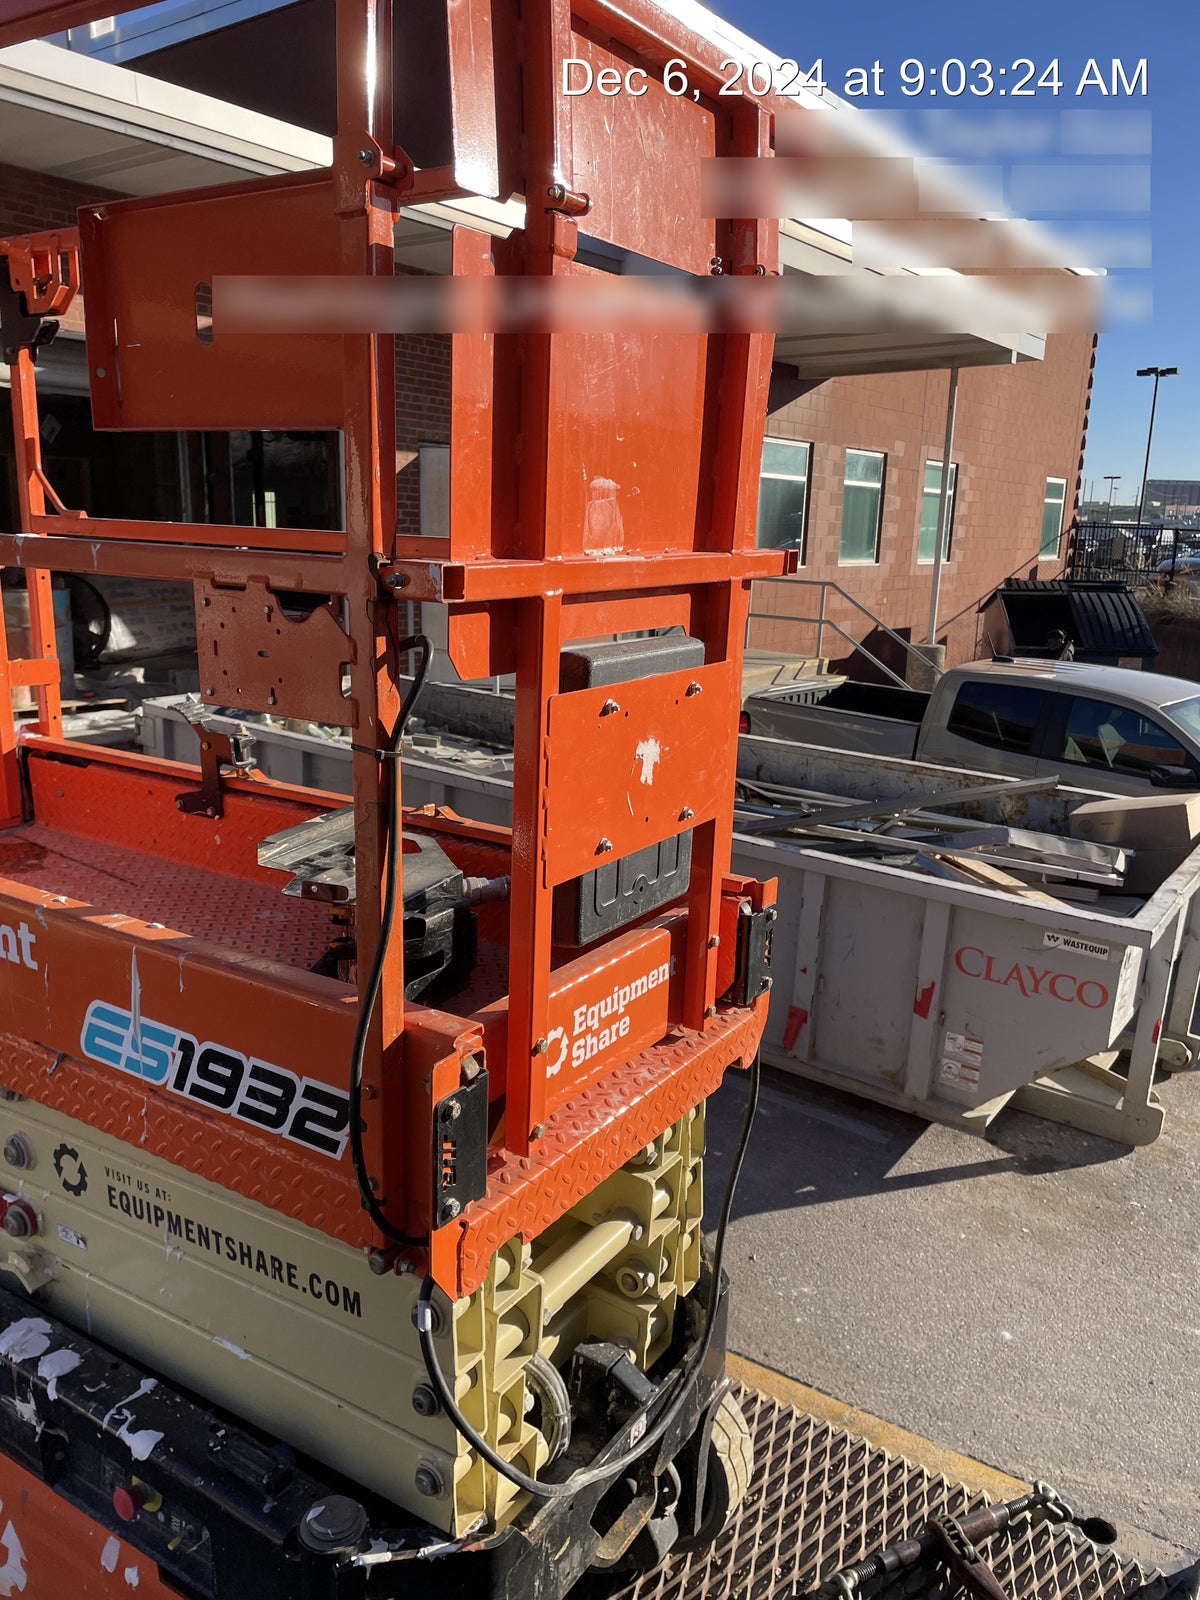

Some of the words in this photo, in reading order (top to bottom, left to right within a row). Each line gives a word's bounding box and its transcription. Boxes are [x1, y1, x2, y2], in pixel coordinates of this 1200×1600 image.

[954, 946, 1109, 1009] CLAYCO
[1063, 938, 1108, 956] WASTEQUIP
[572, 954, 676, 1037] Equipment
[571, 1015, 631, 1069] Share
[82, 1004, 350, 1156] ES1932
[104, 1165, 133, 1187] VISIT
[136, 1179, 151, 1194] US
[154, 1187, 172, 1203] AT:
[107, 1184, 362, 1318] EQUIPMENTSHARE.COM
